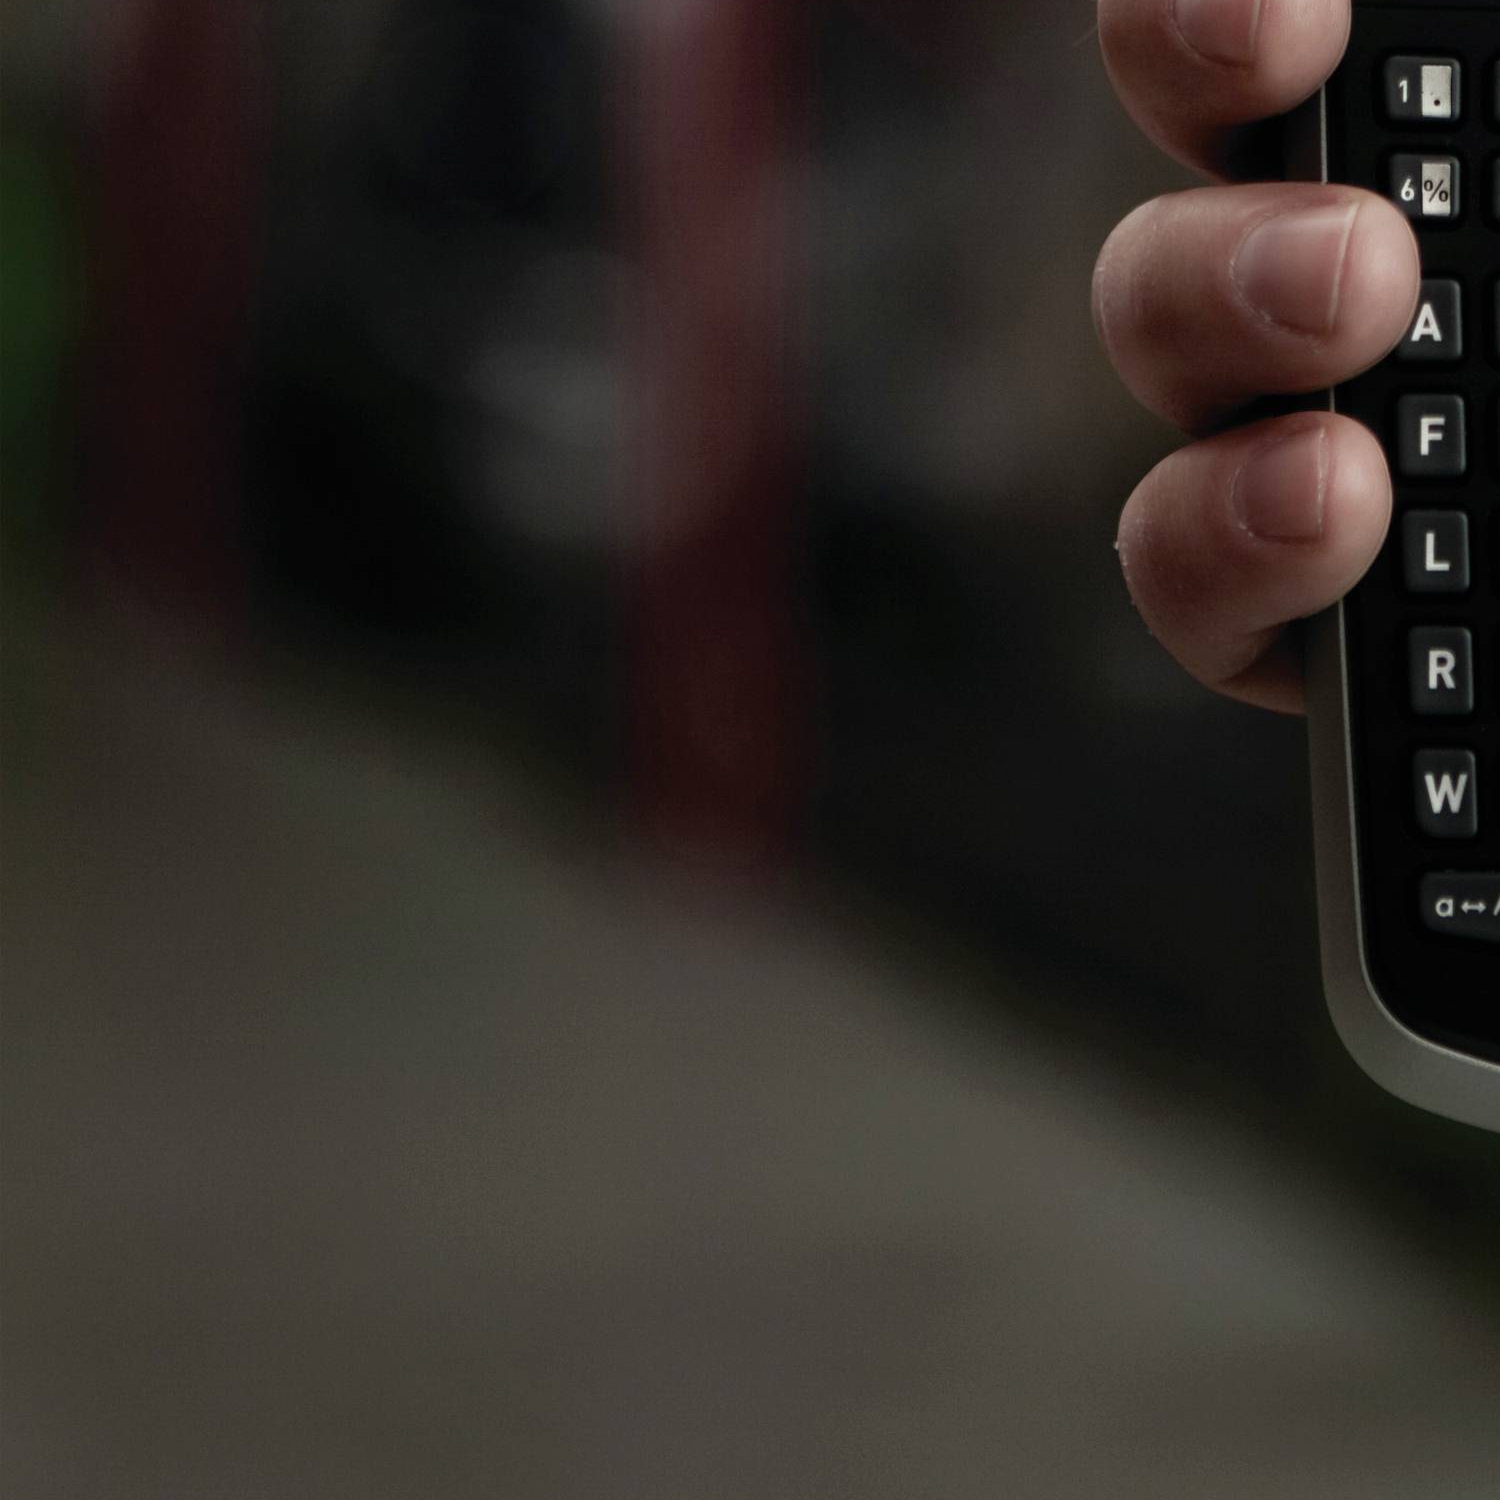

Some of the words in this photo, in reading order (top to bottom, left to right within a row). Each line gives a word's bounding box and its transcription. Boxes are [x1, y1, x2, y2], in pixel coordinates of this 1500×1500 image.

[1399, 79, 1408, 103] 1
[1400, 178, 1415, 201] 6
[1411, 303, 1442, 343] A
[1420, 416, 1445, 456] F
[1425, 532, 1450, 571] L
[1428, 650, 1455, 689] R
[1424, 774, 1467, 814] W
[1435, 898, 1454, 917] a
